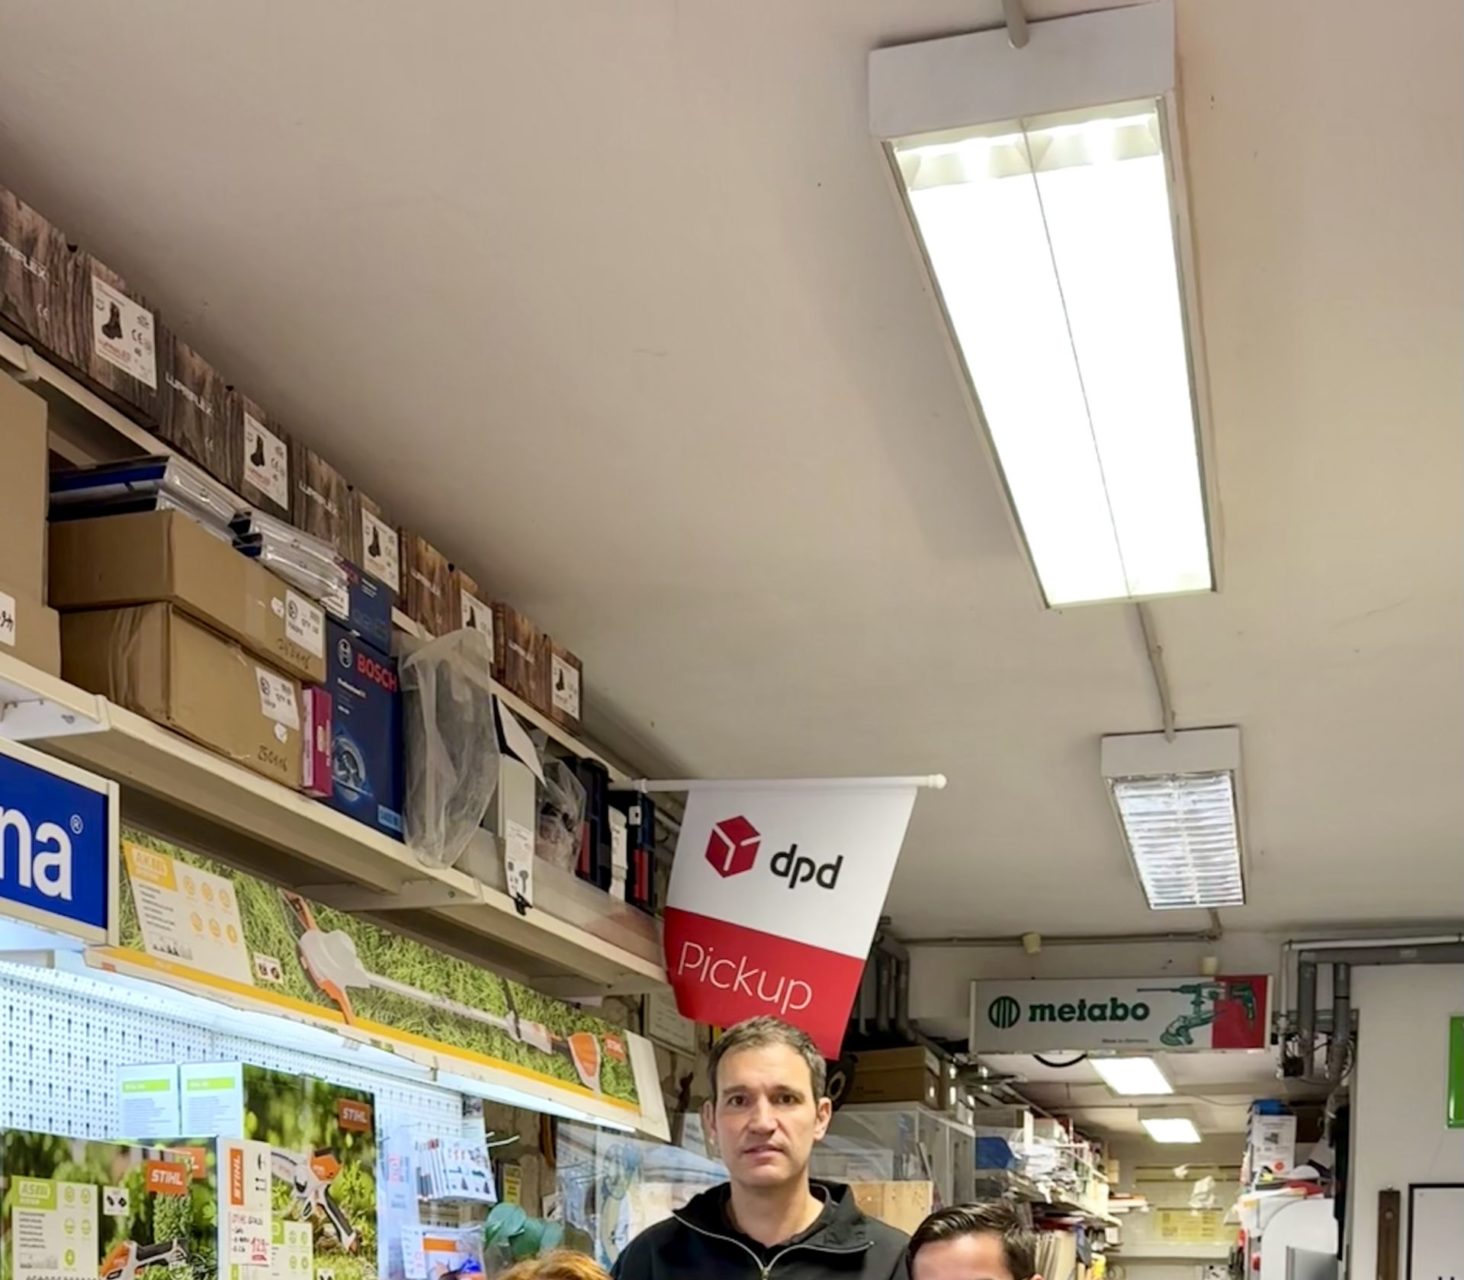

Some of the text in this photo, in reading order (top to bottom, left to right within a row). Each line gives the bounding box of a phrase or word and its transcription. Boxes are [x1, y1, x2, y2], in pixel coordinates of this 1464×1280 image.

[357, 653, 397, 692] BOSCH
[769, 843, 844, 890] dpd
[677, 941, 813, 1015] Pickup
[1028, 997, 1150, 1023] metabo
[342, 1107, 367, 1124] STIHL
[151, 1169, 183, 1186] STIHL
[232, 1155, 242, 1198] STIHL
